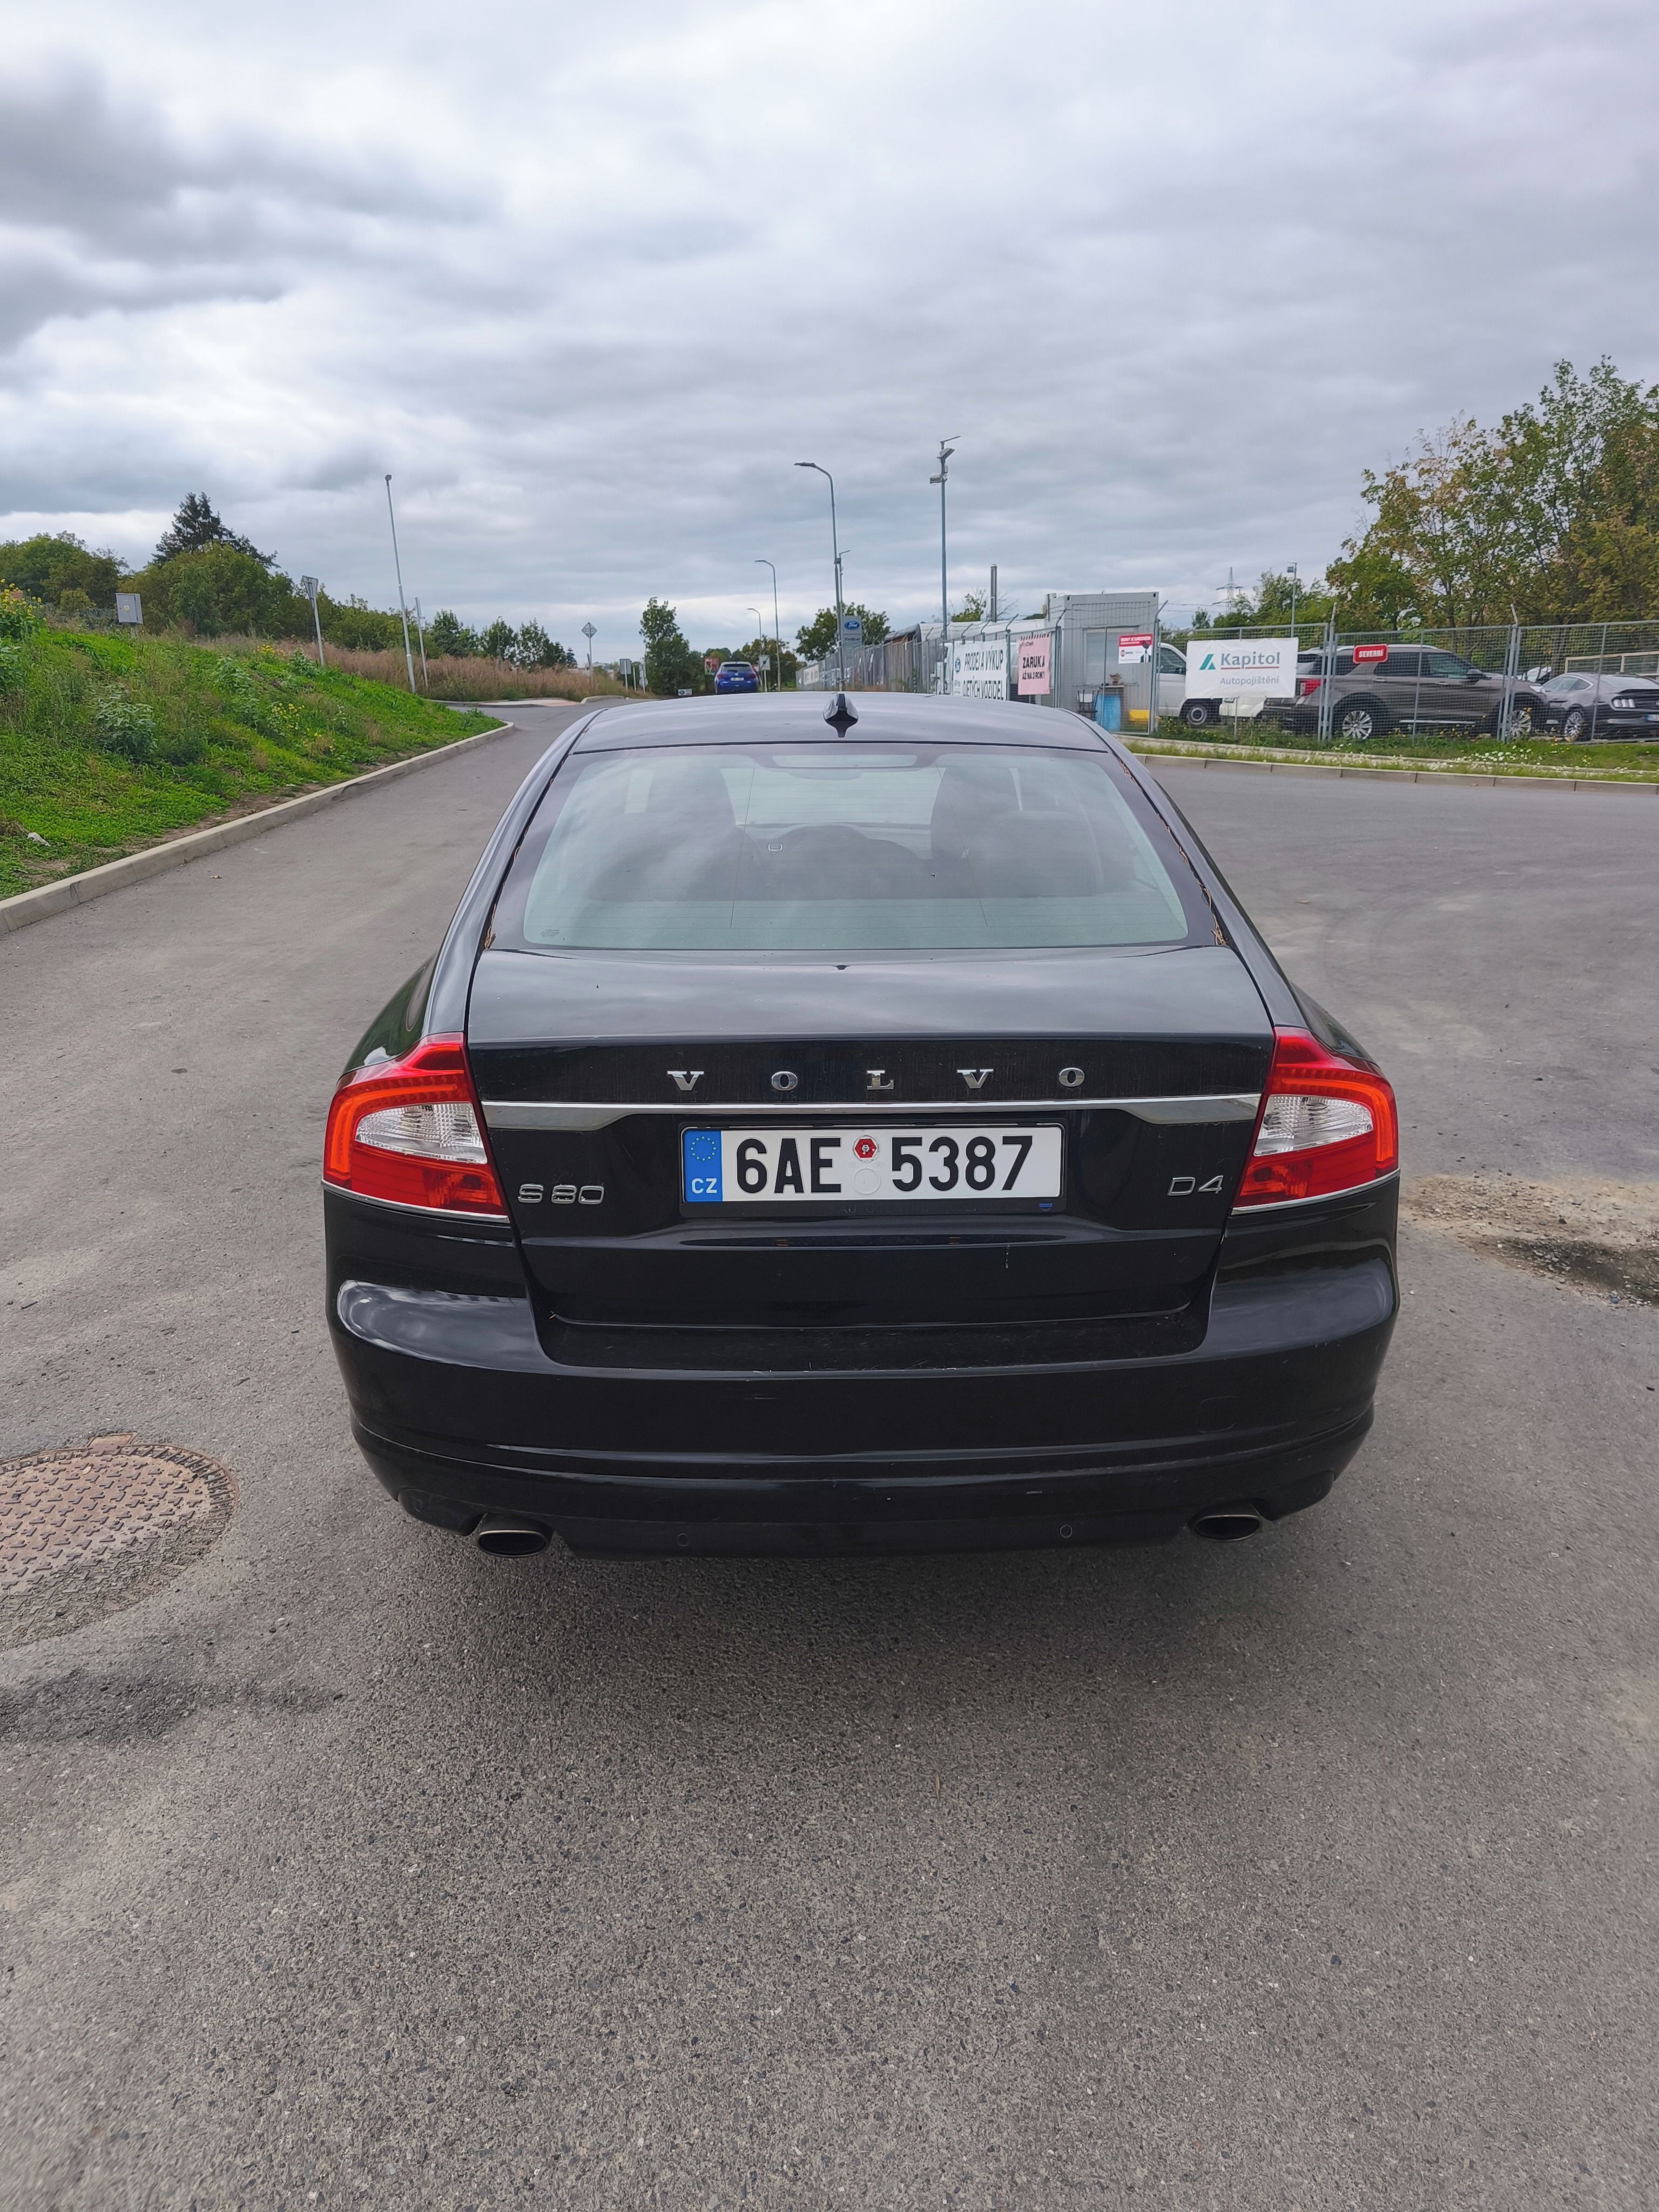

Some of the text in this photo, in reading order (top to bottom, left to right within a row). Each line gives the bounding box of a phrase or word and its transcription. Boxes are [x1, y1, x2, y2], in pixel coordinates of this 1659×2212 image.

[964, 651, 980, 671] PRODEJ
[981, 651, 984, 671] A
[986, 645, 1003, 671] VÝKUP
[1022, 653, 1045, 669] ZÁRUKA
[1220, 651, 1280, 669] Kapitol
[981, 680, 1004, 700] VOZIDEL
[1220, 676, 1279, 686] Autopojištění
[667, 1067, 1085, 1091] VOLVO
[736, 1135, 1033, 1194] 6AE 5387
[691, 1178, 717, 1194] CZ
[1168, 1175, 1224, 1196] D4
